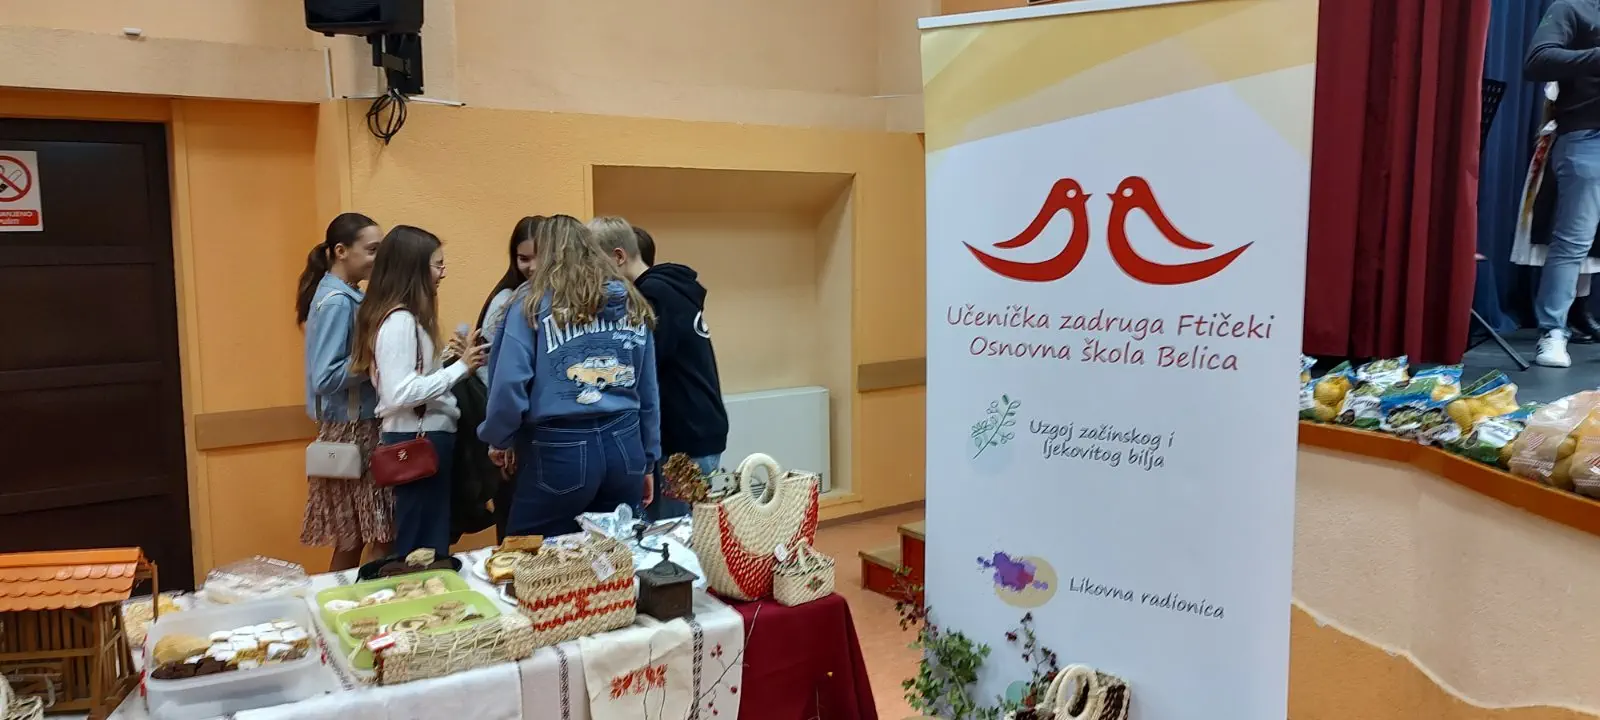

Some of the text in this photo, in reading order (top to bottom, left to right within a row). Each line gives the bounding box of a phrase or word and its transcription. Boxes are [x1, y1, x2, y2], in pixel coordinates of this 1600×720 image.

[946, 303, 1275, 340] Učenička zadruga Ftičeki
[969, 336, 1238, 370] Osnovna škola Belica
[1029, 419, 1176, 451] Uzgoj začinskog i
[1043, 438, 1164, 471] ljekovitog bilja
[1069, 576, 1224, 619] Likovna radionica
